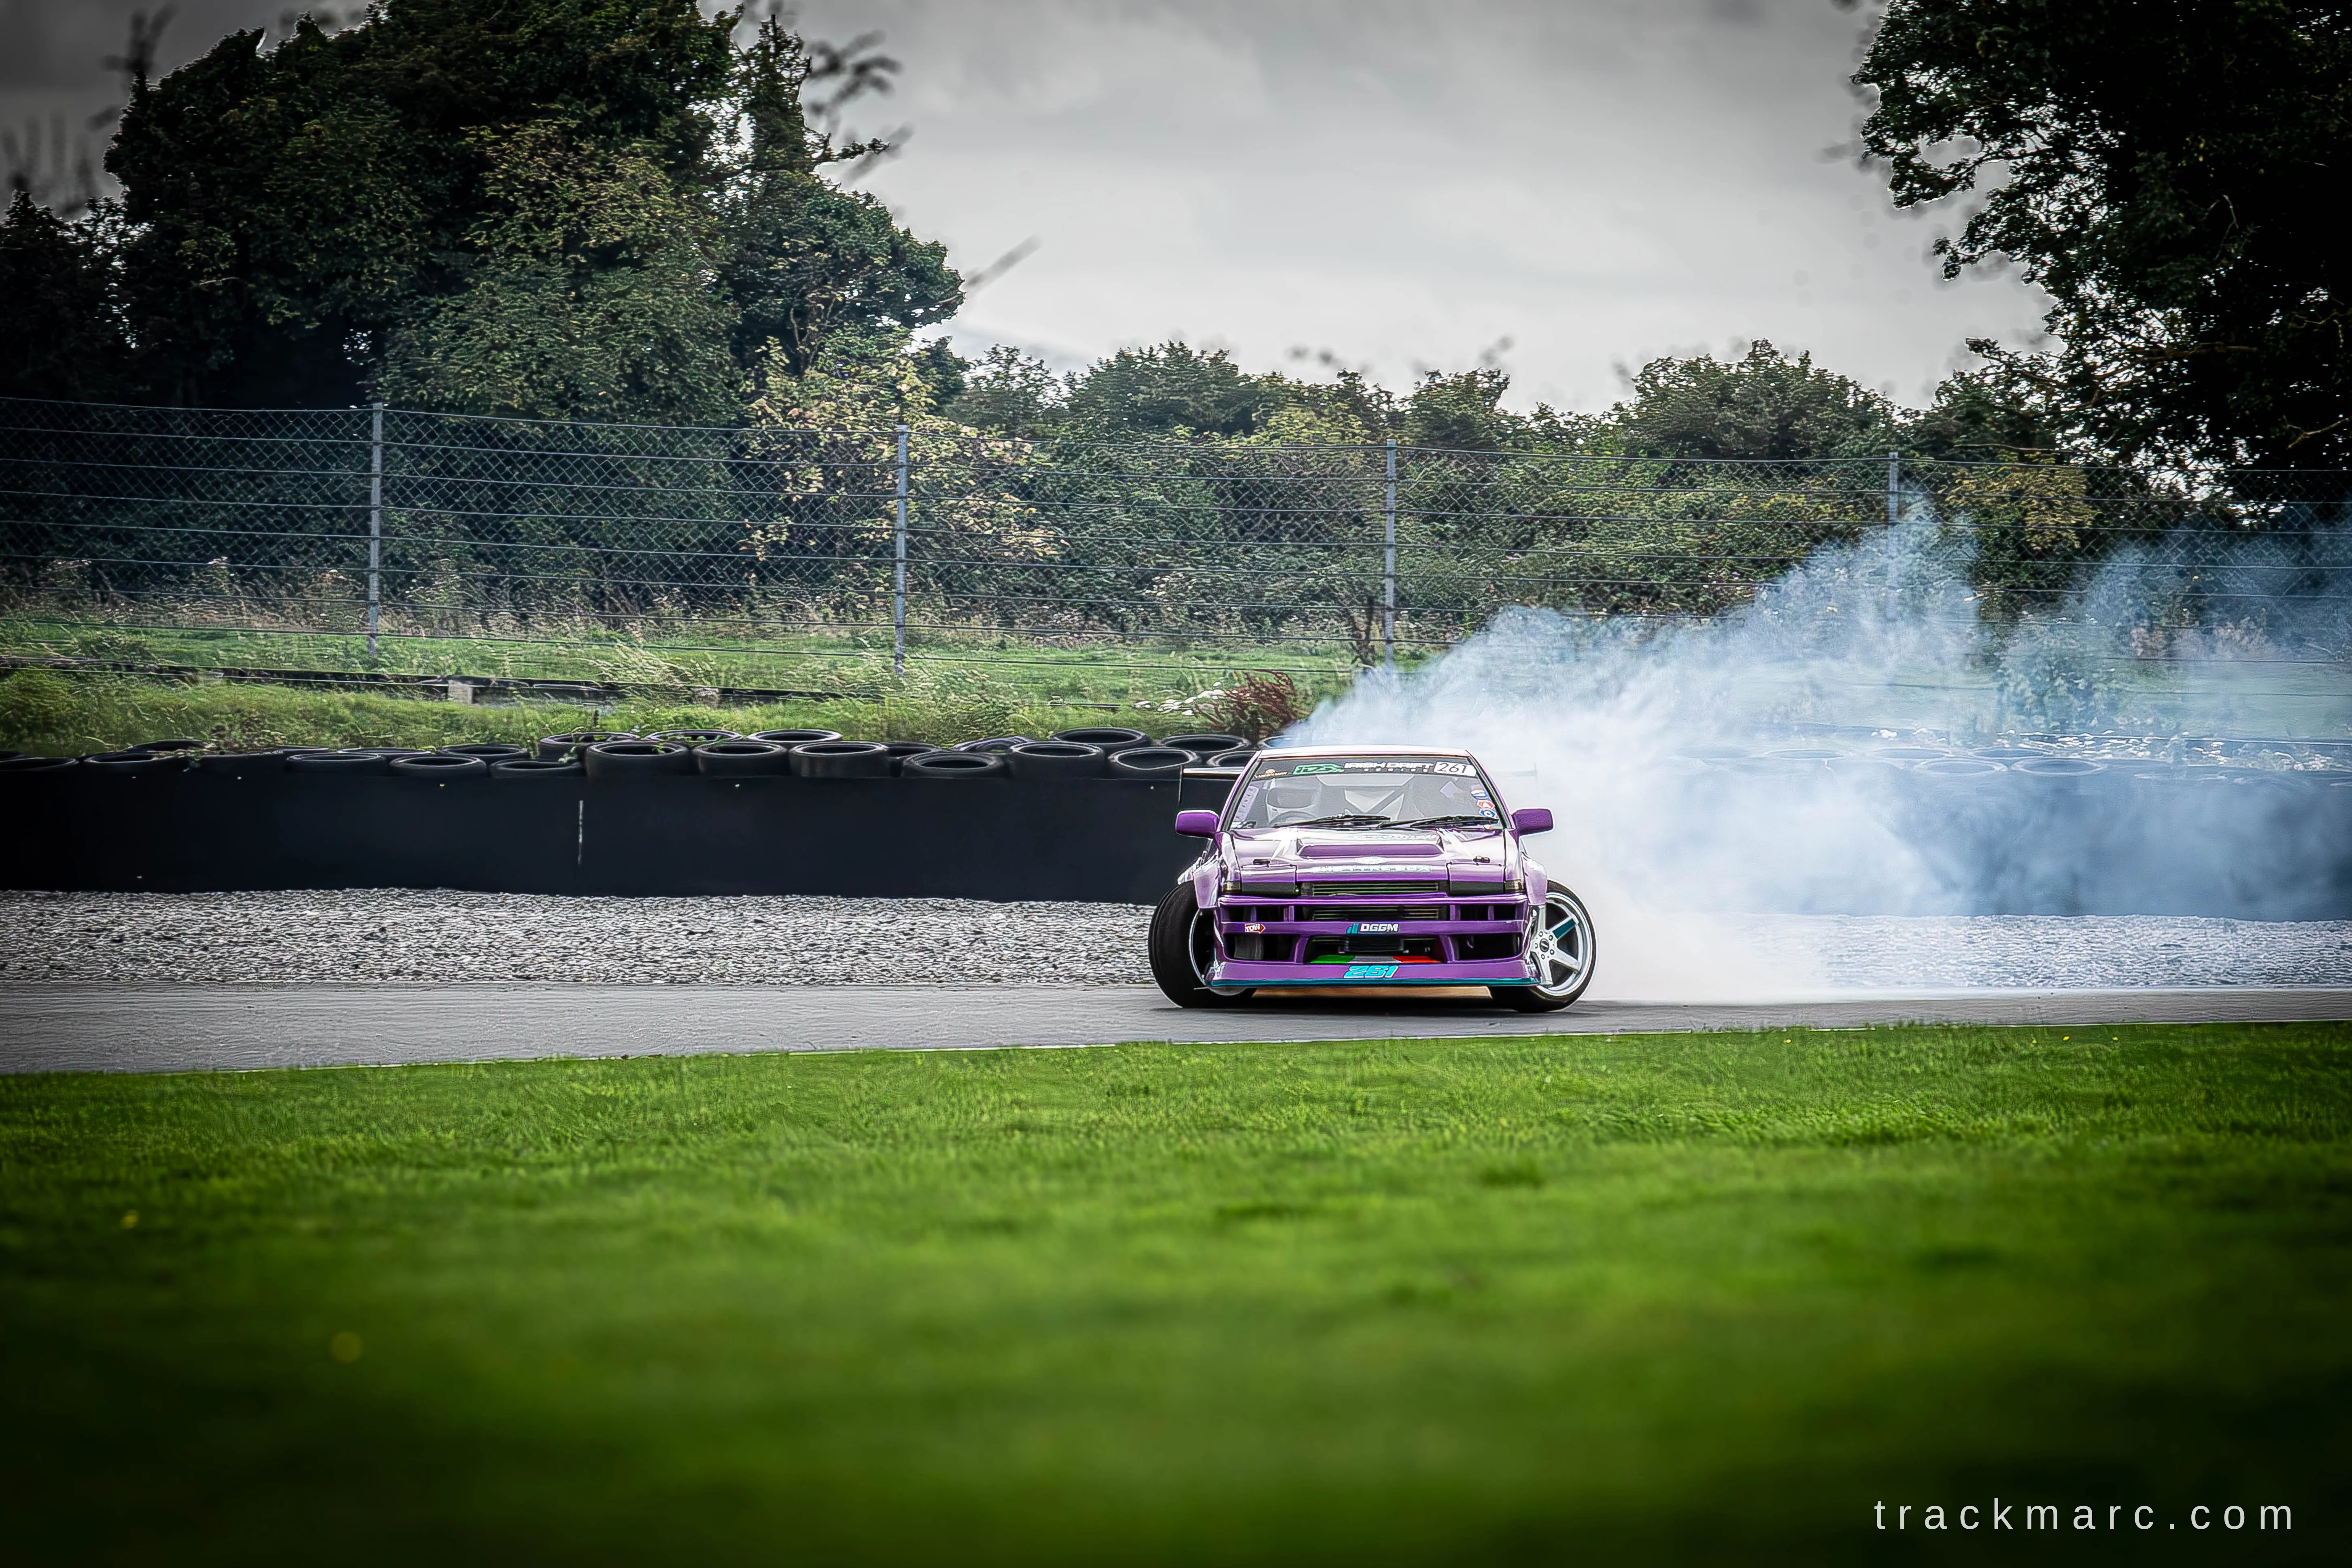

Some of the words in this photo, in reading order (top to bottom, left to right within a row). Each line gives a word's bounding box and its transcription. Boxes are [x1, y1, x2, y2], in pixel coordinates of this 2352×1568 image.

[1437, 763, 1466, 773] 261
[1245, 923, 1260, 932] TOW
[1360, 923, 1399, 932] DGGM
[1343, 965, 1399, 978] 261
